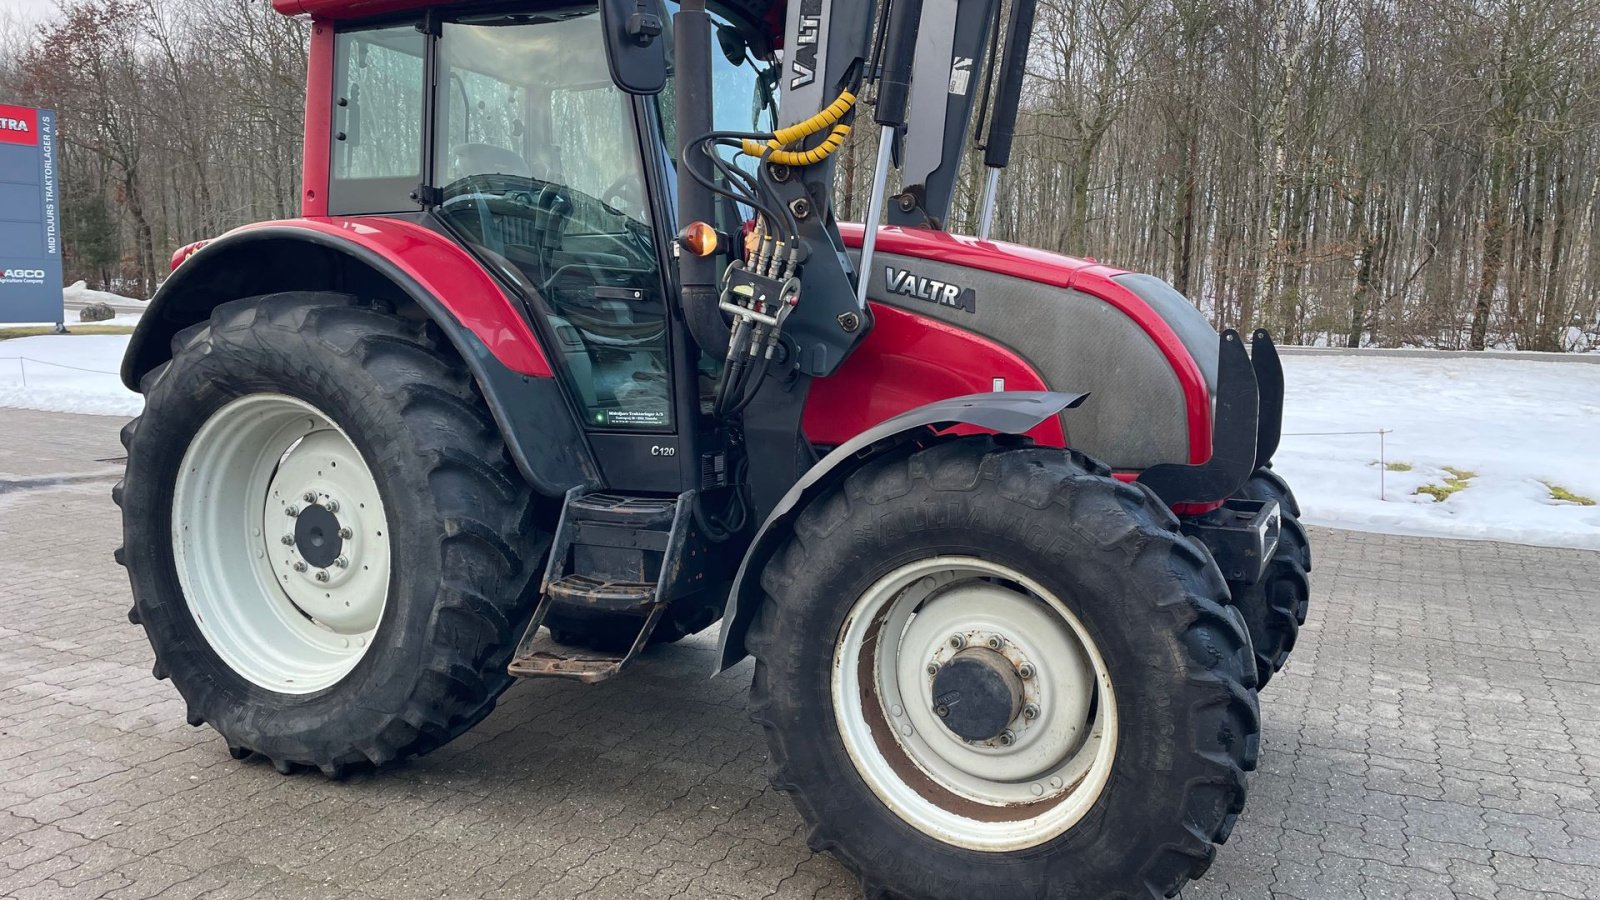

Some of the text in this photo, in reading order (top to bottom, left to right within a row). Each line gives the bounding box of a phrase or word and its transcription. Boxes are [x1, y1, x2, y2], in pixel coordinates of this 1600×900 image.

[0, 117, 29, 132] TRA
[42, 116, 56, 254] MIDTDJURS TRAKTORLAGER A/S
[4, 269, 45, 278] AGCO
[885, 266, 976, 314] VALTRA
[651, 445, 675, 456] C120
